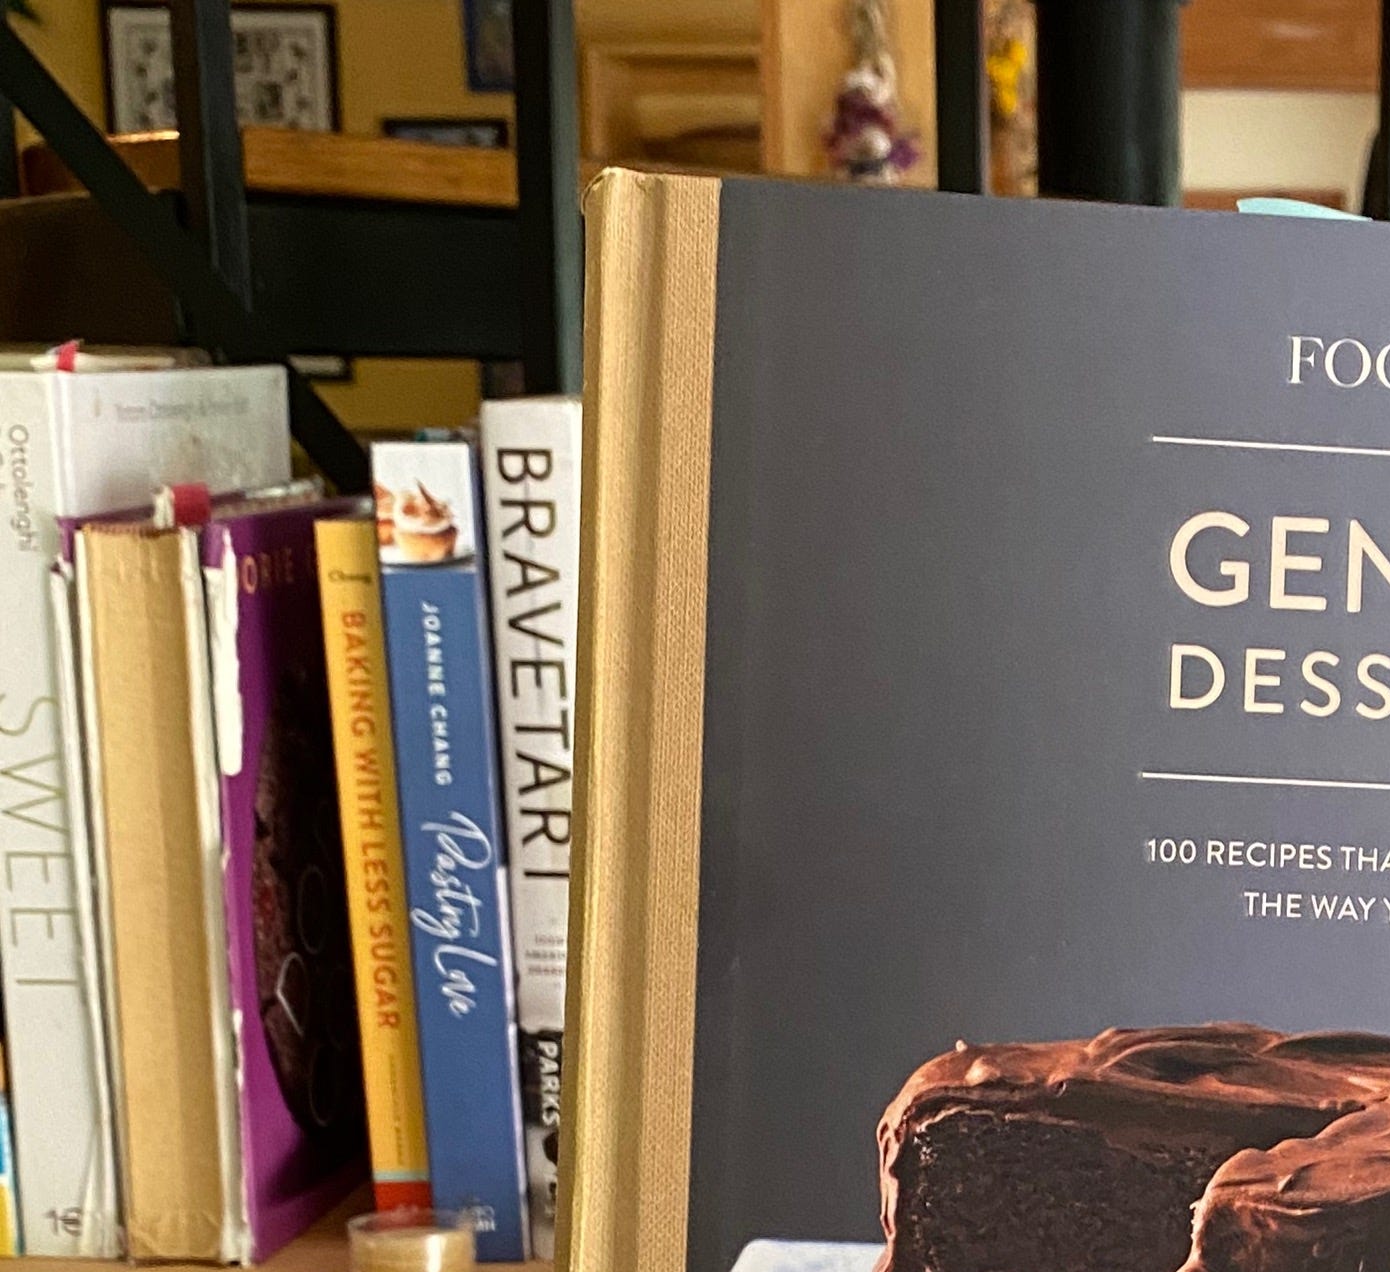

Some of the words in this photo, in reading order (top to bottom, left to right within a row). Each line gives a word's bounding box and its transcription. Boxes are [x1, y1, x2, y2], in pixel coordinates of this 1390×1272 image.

[9, 424, 36, 551] Ottolenghi
[343, 611, 376, 738] BAKING
[421, 600, 446, 697] JOANNE
[431, 704, 453, 786] CHANG
[356, 751, 384, 832] WITH
[361, 841, 391, 914] LESS
[1146, 839, 1197, 866] 100
[1206, 840, 1333, 872] RECIPES
[1243, 891, 1302, 919] THE
[1311, 893, 1374, 924] WAY
[369, 923, 400, 1030] SUGAR
[538, 1042, 560, 1126] PARKS
